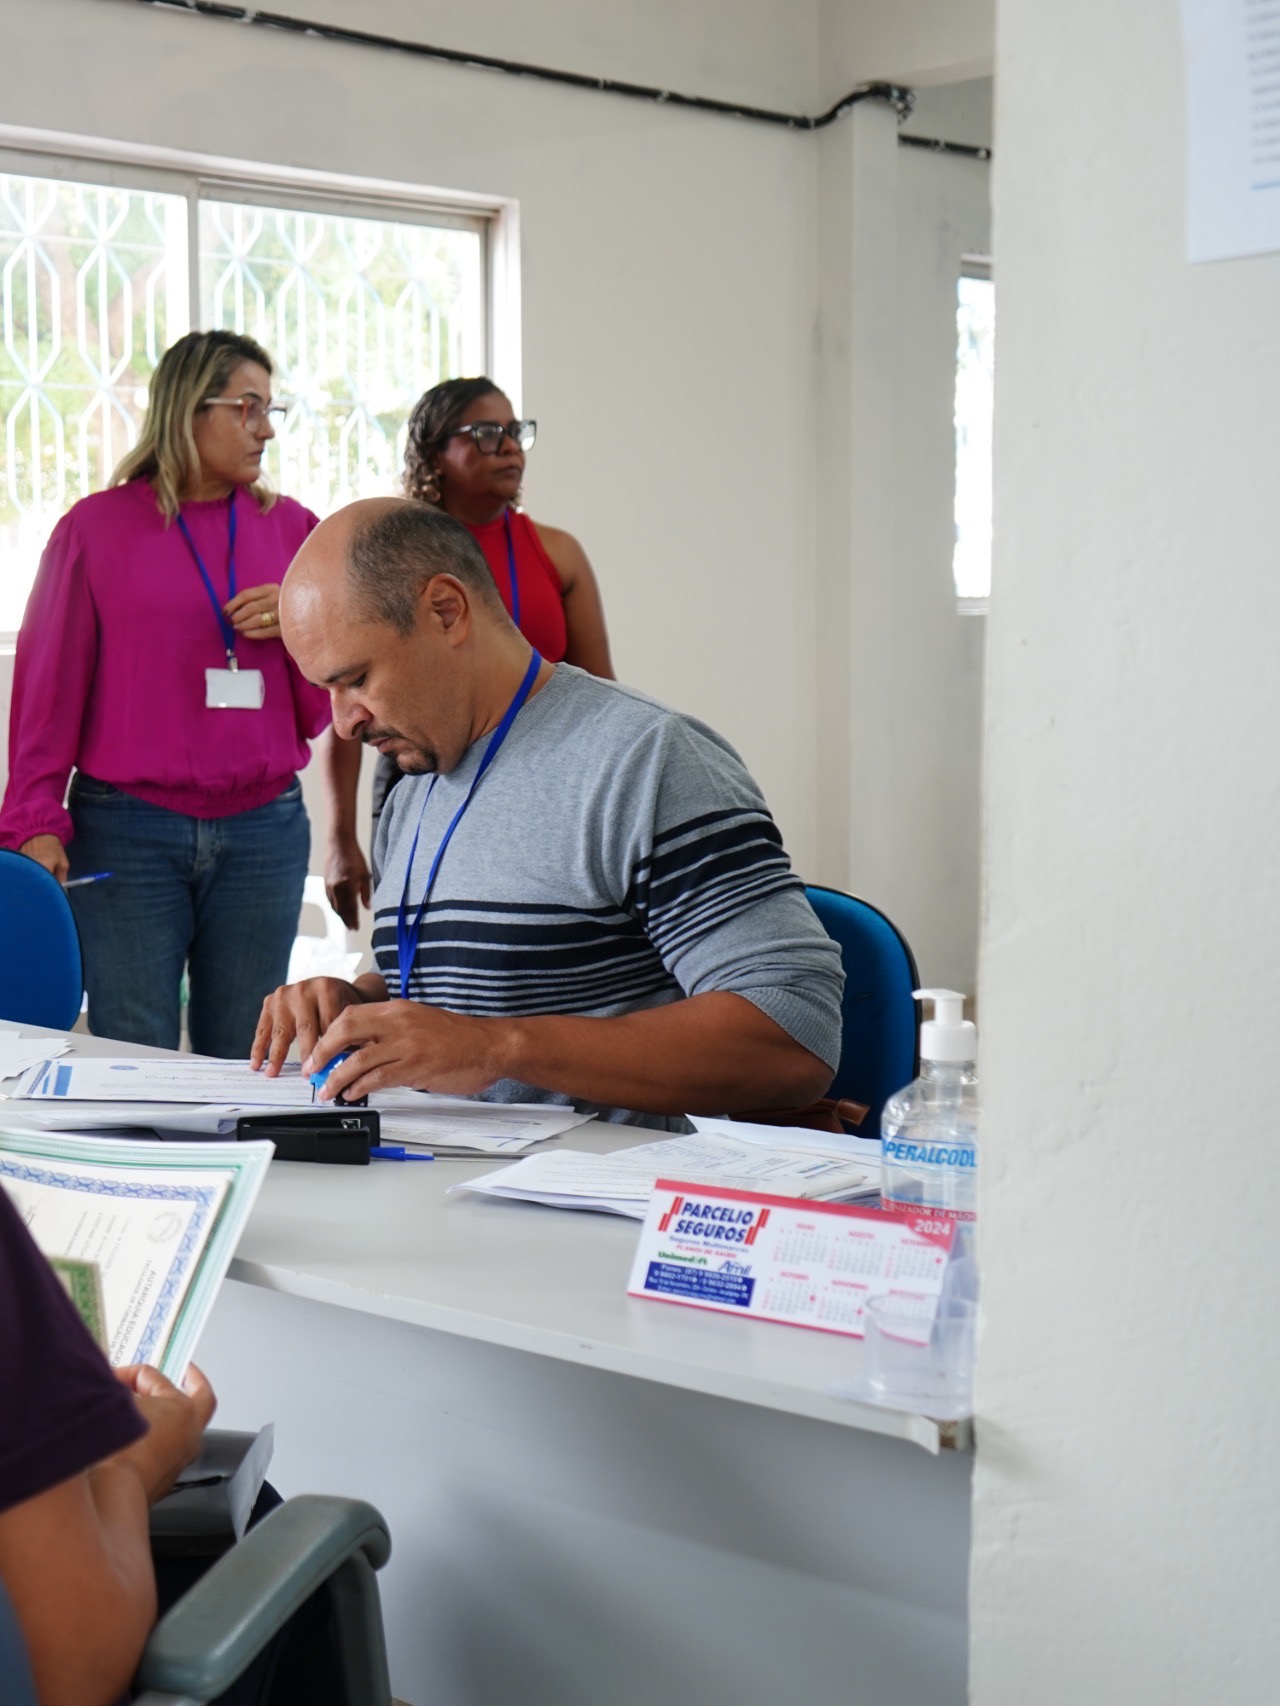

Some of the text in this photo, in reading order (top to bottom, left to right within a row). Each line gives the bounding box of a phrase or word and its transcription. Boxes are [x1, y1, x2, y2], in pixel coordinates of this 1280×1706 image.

[682, 1202, 754, 1225] PARCELIO
[675, 1220, 747, 1242] SEGUROS
[915, 1219, 951, 1236] 2024
